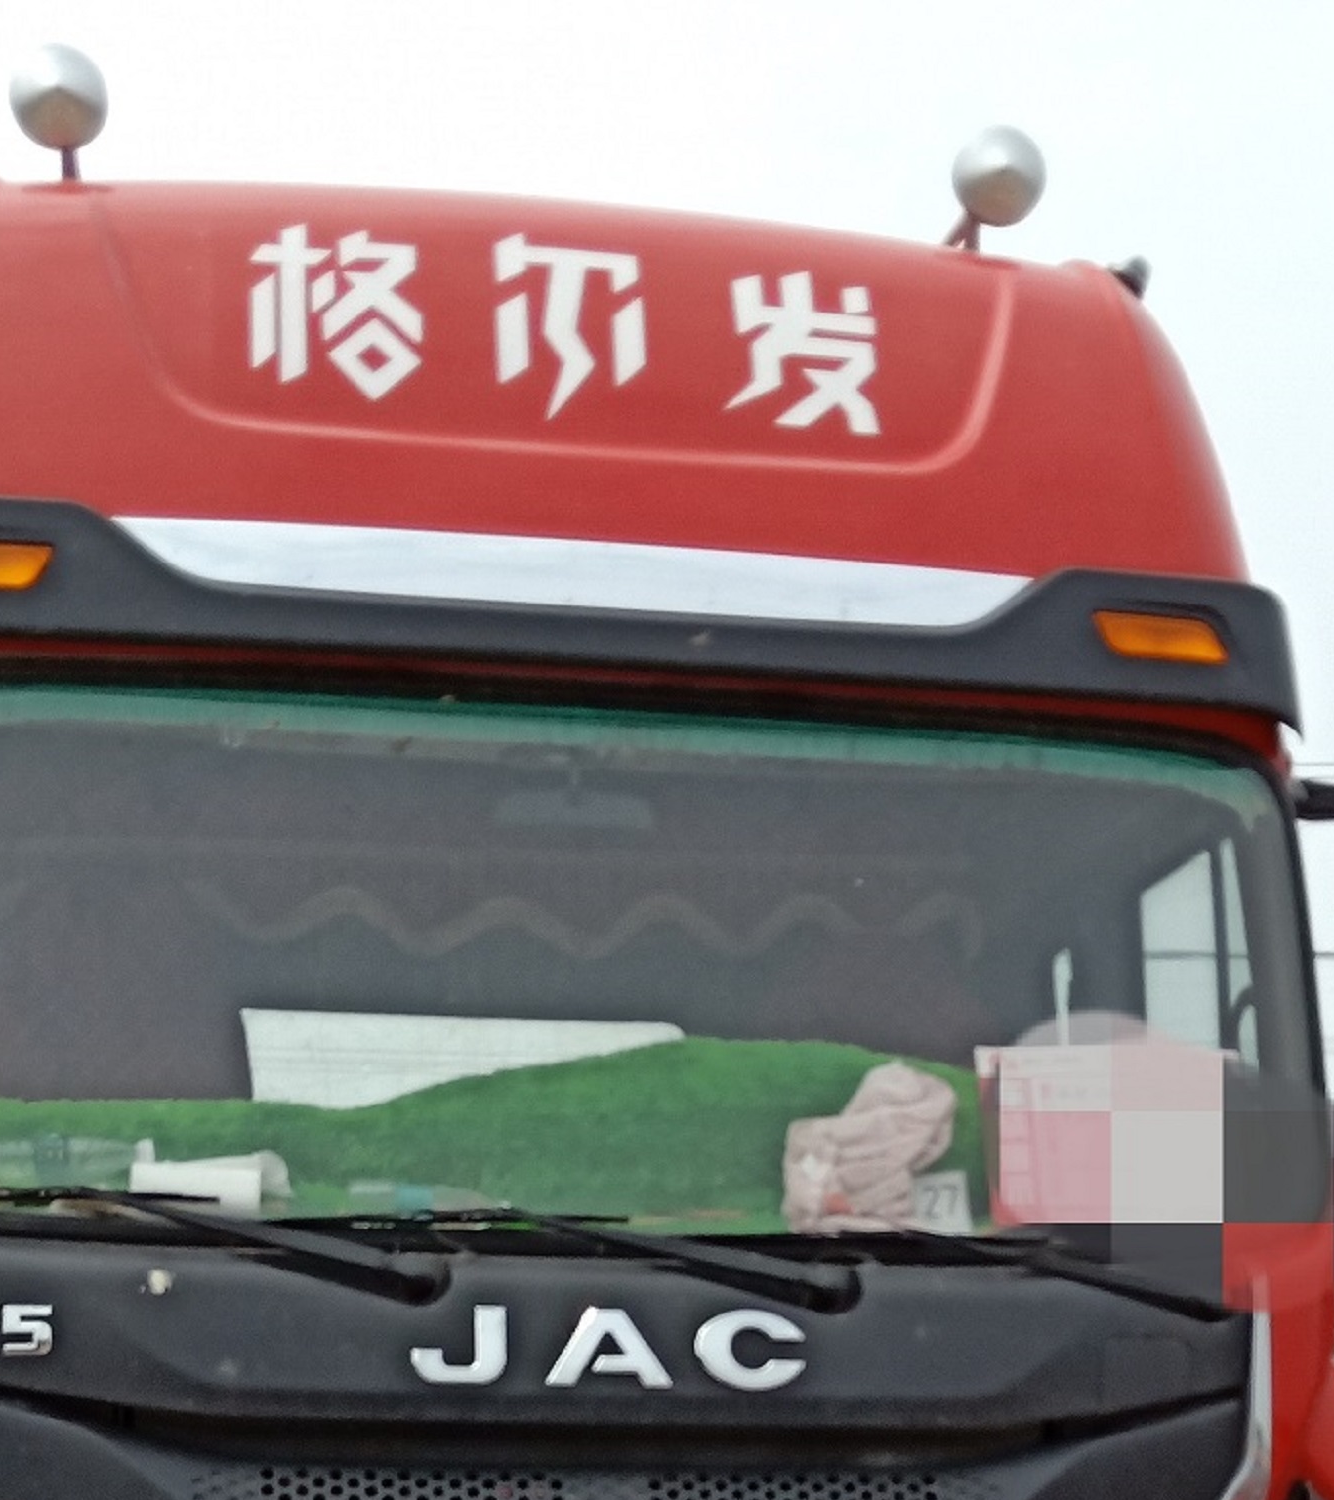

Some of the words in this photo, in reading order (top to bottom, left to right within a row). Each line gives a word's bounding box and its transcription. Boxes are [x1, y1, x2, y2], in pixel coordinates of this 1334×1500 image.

[249, 222, 881, 437] 格尔发
[409, 1304, 808, 1392] JAC
